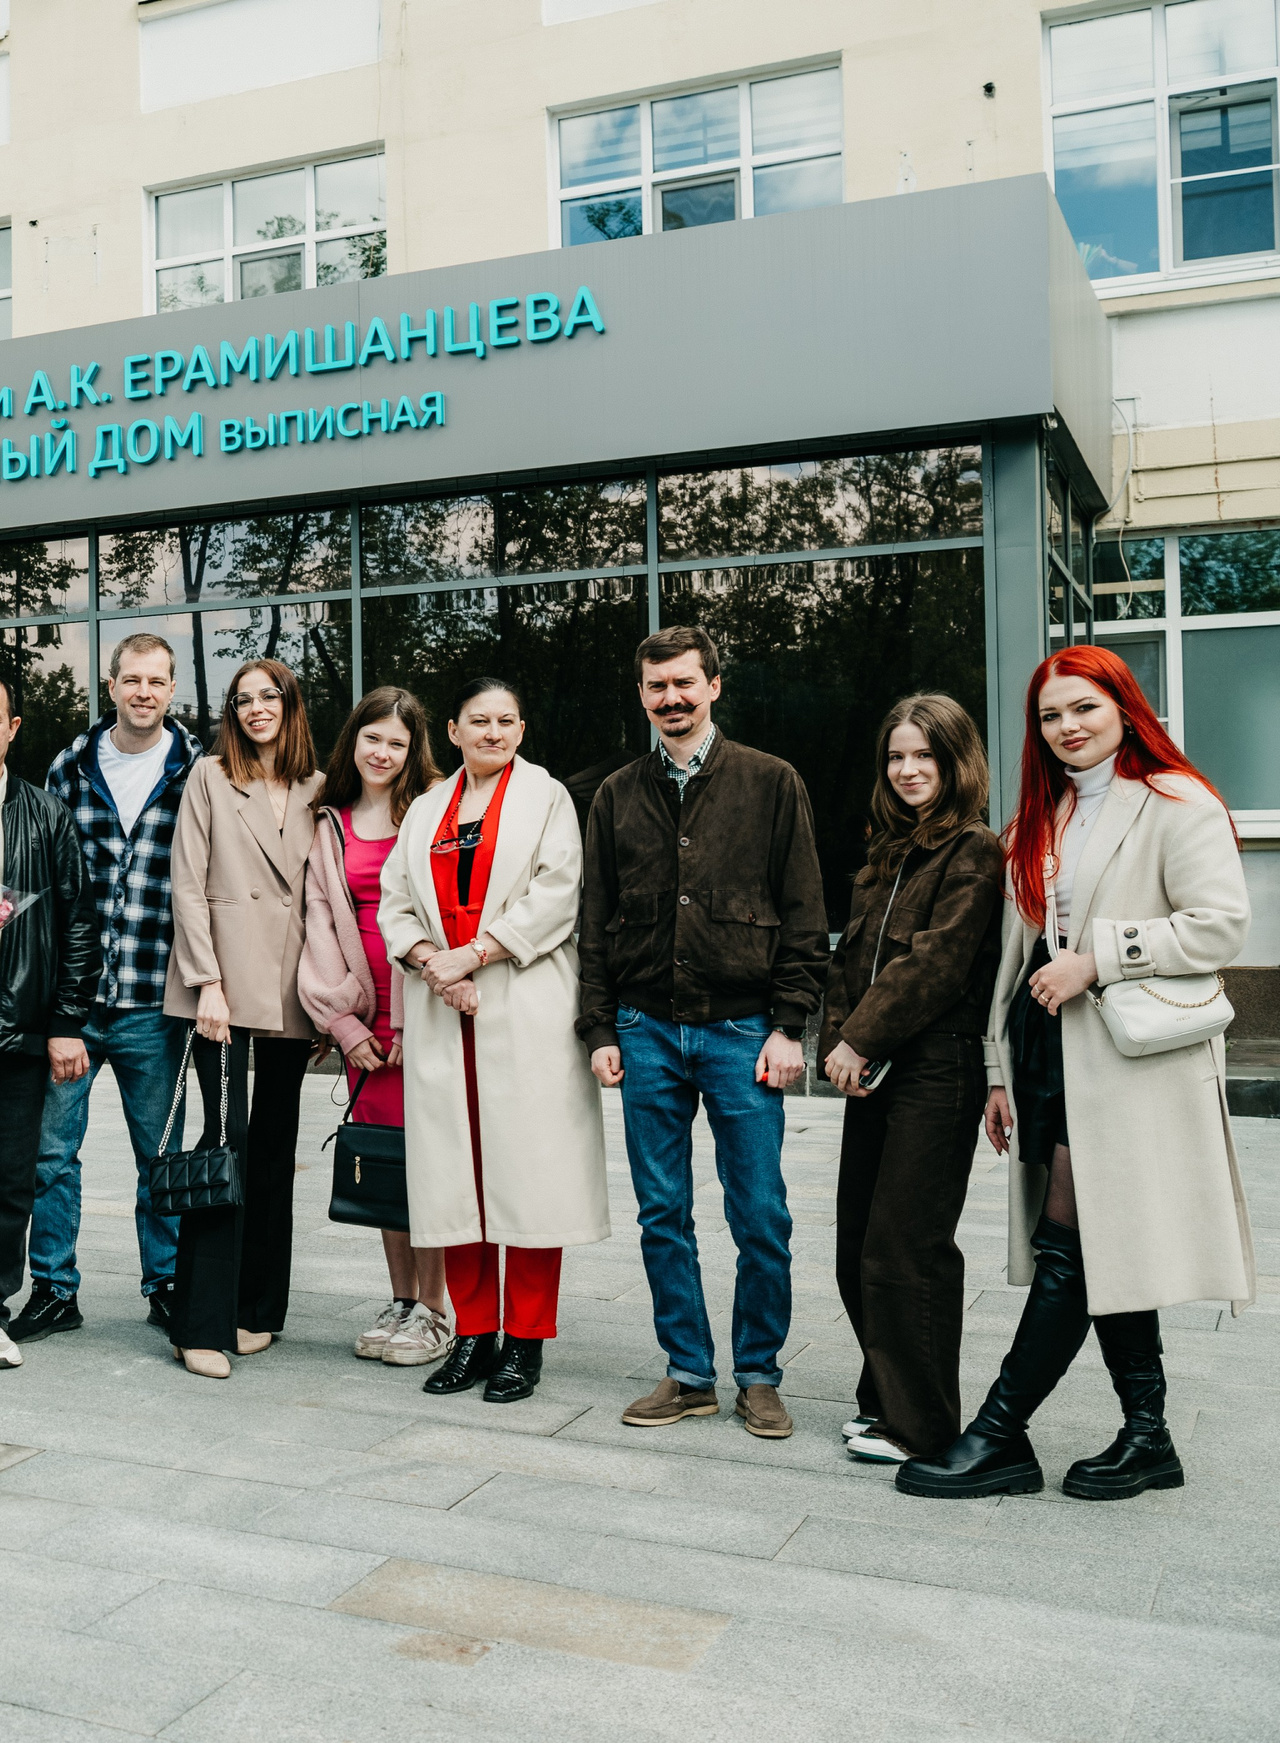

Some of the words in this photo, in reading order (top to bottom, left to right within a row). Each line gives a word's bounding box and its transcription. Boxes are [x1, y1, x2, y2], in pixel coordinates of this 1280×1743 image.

[24, 361, 113, 415] А.К.
[124, 285, 605, 400] ЕРАМИШАНЦЕВА
[88, 411, 204, 478] ДОМ
